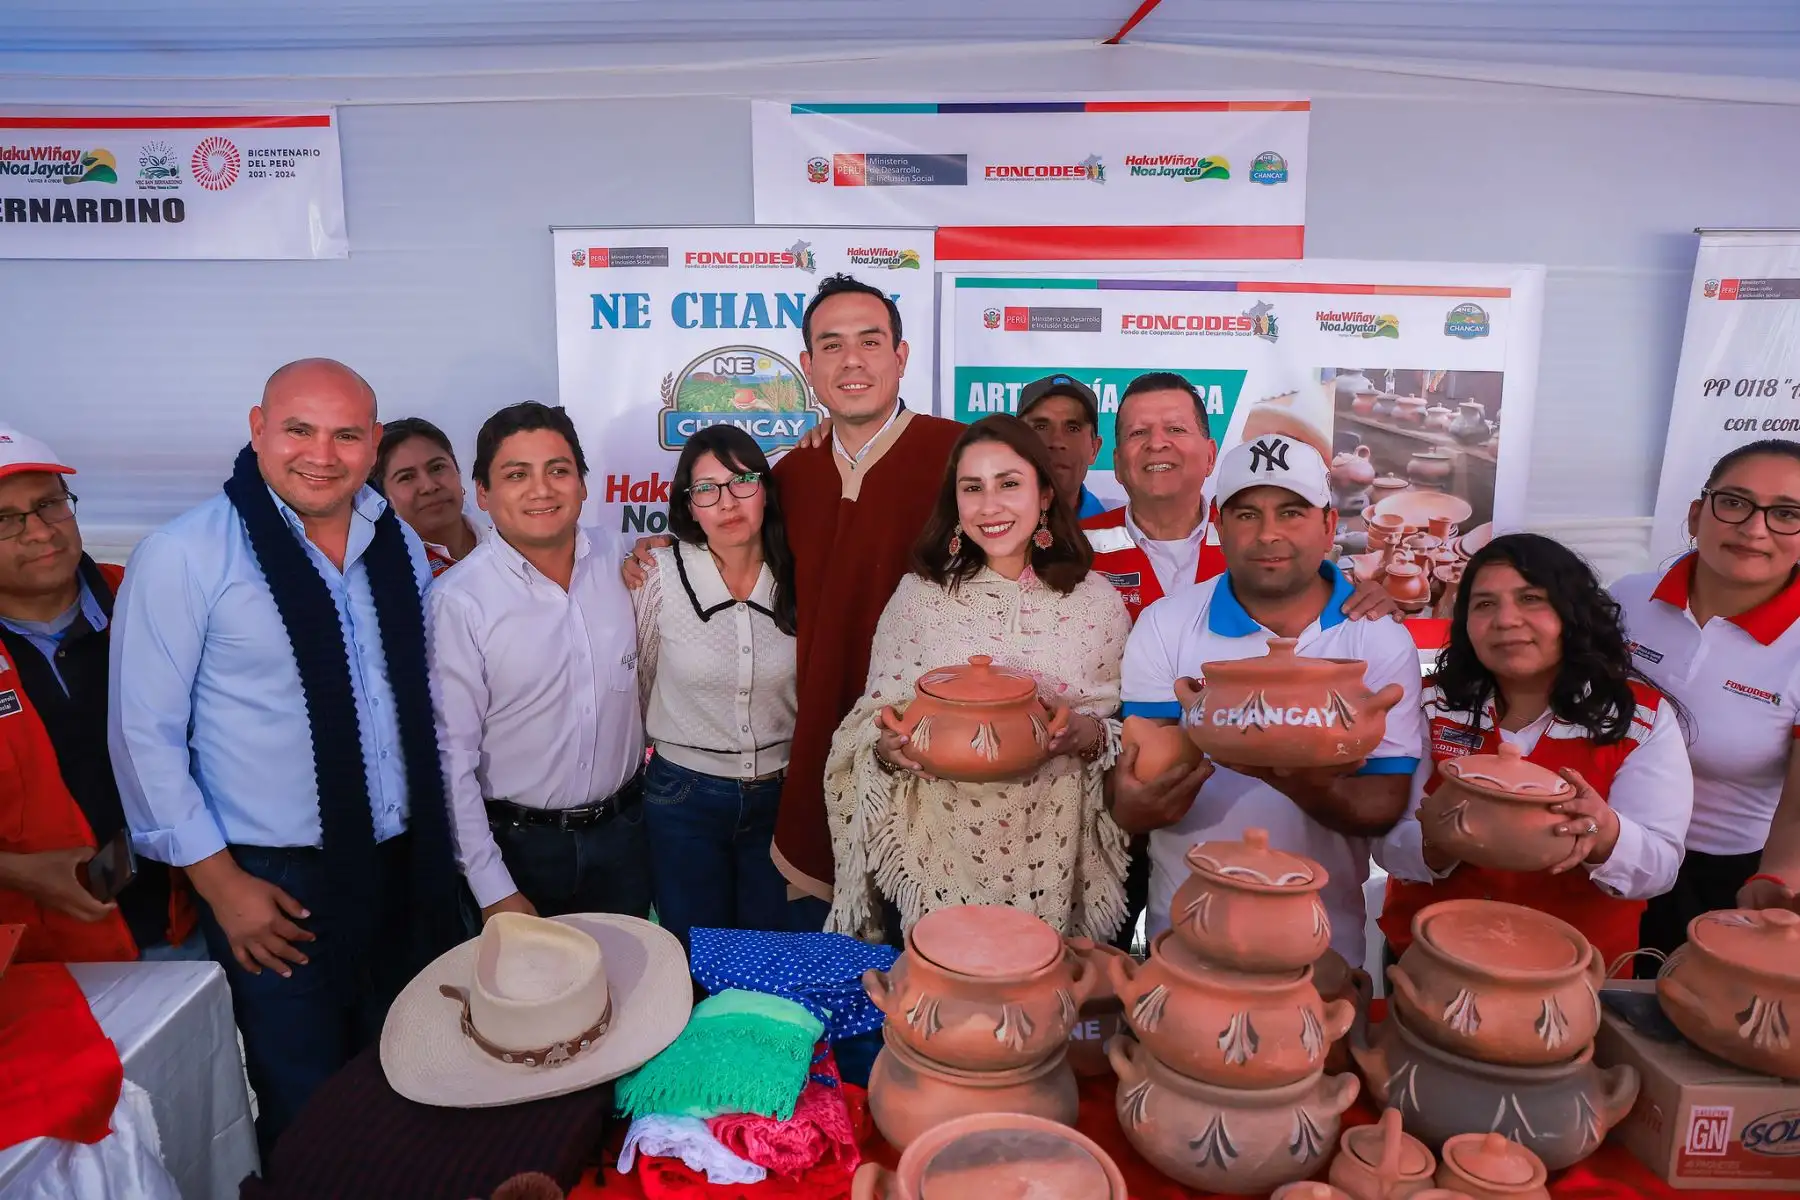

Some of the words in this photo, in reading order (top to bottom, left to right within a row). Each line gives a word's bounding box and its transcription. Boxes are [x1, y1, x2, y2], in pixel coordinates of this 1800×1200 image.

[248, 149, 320, 157] BICENTENARIO
[248, 160, 266, 168] DEL
[269, 158, 295, 168] PERÚ
[985, 166, 1086, 177] FONCODES
[876, 174, 909, 182] Inclusión
[912, 174, 934, 182] Social
[0, 198, 185, 223] RNARDINO
[685, 252, 794, 264] FONCODES
[590, 292, 652, 330] NE
[1121, 314, 1252, 331] FONCODES
[714, 357, 755, 376] NE
[1704, 378, 1731, 396] PP
[1734, 378, 1779, 397] 0118
[1724, 418, 1758, 432] con
[1762, 418, 1800, 432] econ
[1726, 680, 1772, 700] FONCODES
[1212, 707, 1338, 728] CHANCAY
[1692, 1118, 1726, 1150] GN
